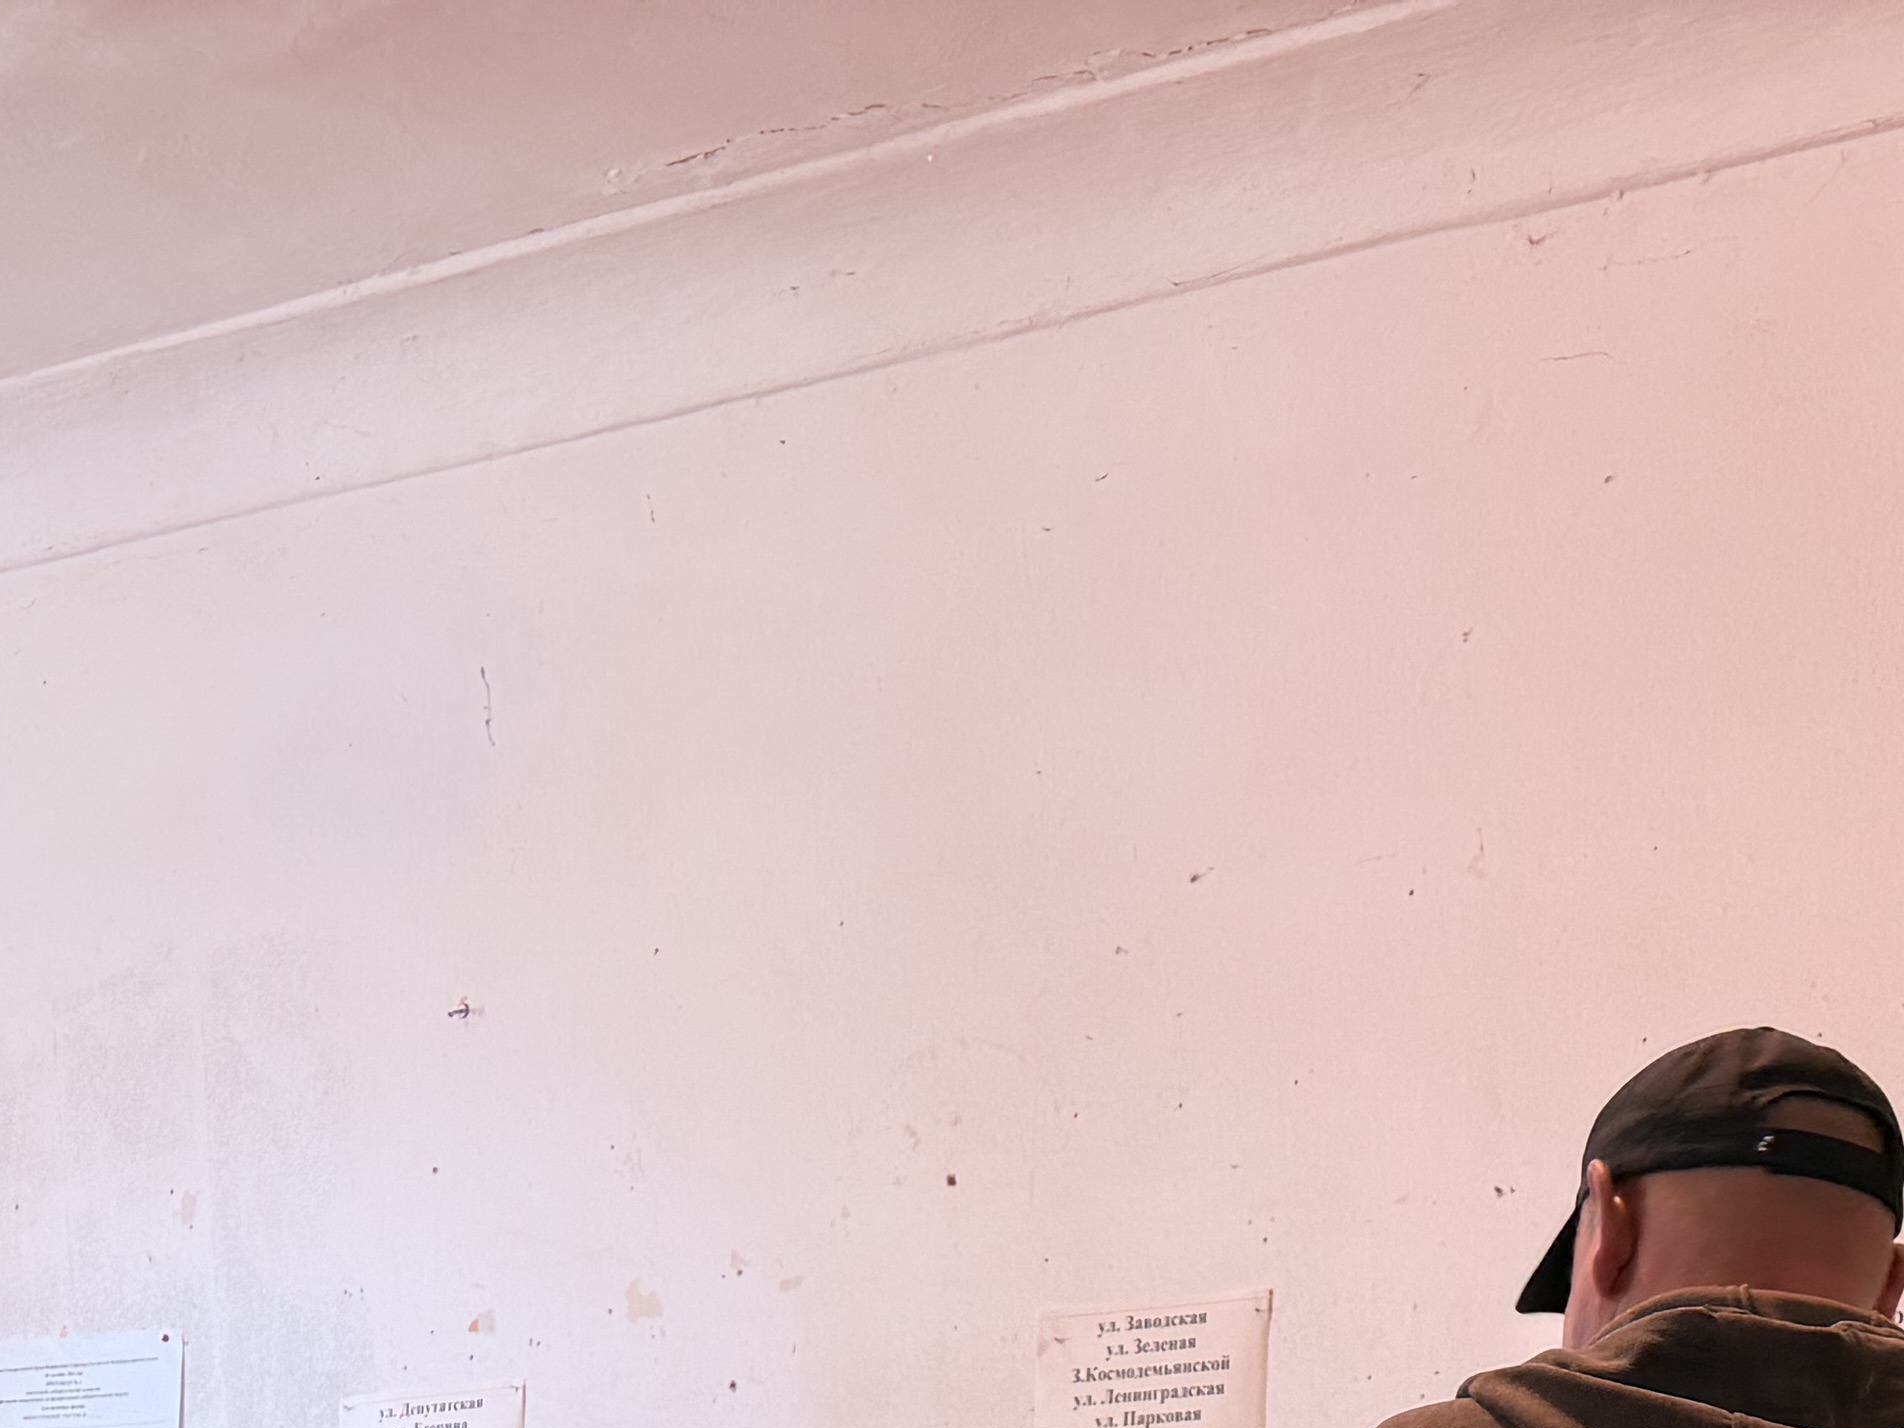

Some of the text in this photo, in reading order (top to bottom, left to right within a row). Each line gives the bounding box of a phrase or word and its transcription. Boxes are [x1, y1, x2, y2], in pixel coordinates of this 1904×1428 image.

[1097, 1312, 1208, 1337] ул. Заводская
[1105, 1336, 1197, 1361] ул. Зеленая
[1073, 1383, 1225, 1410] ул. Ленинградская
[1123, 1409, 1202, 1428] Парковая
